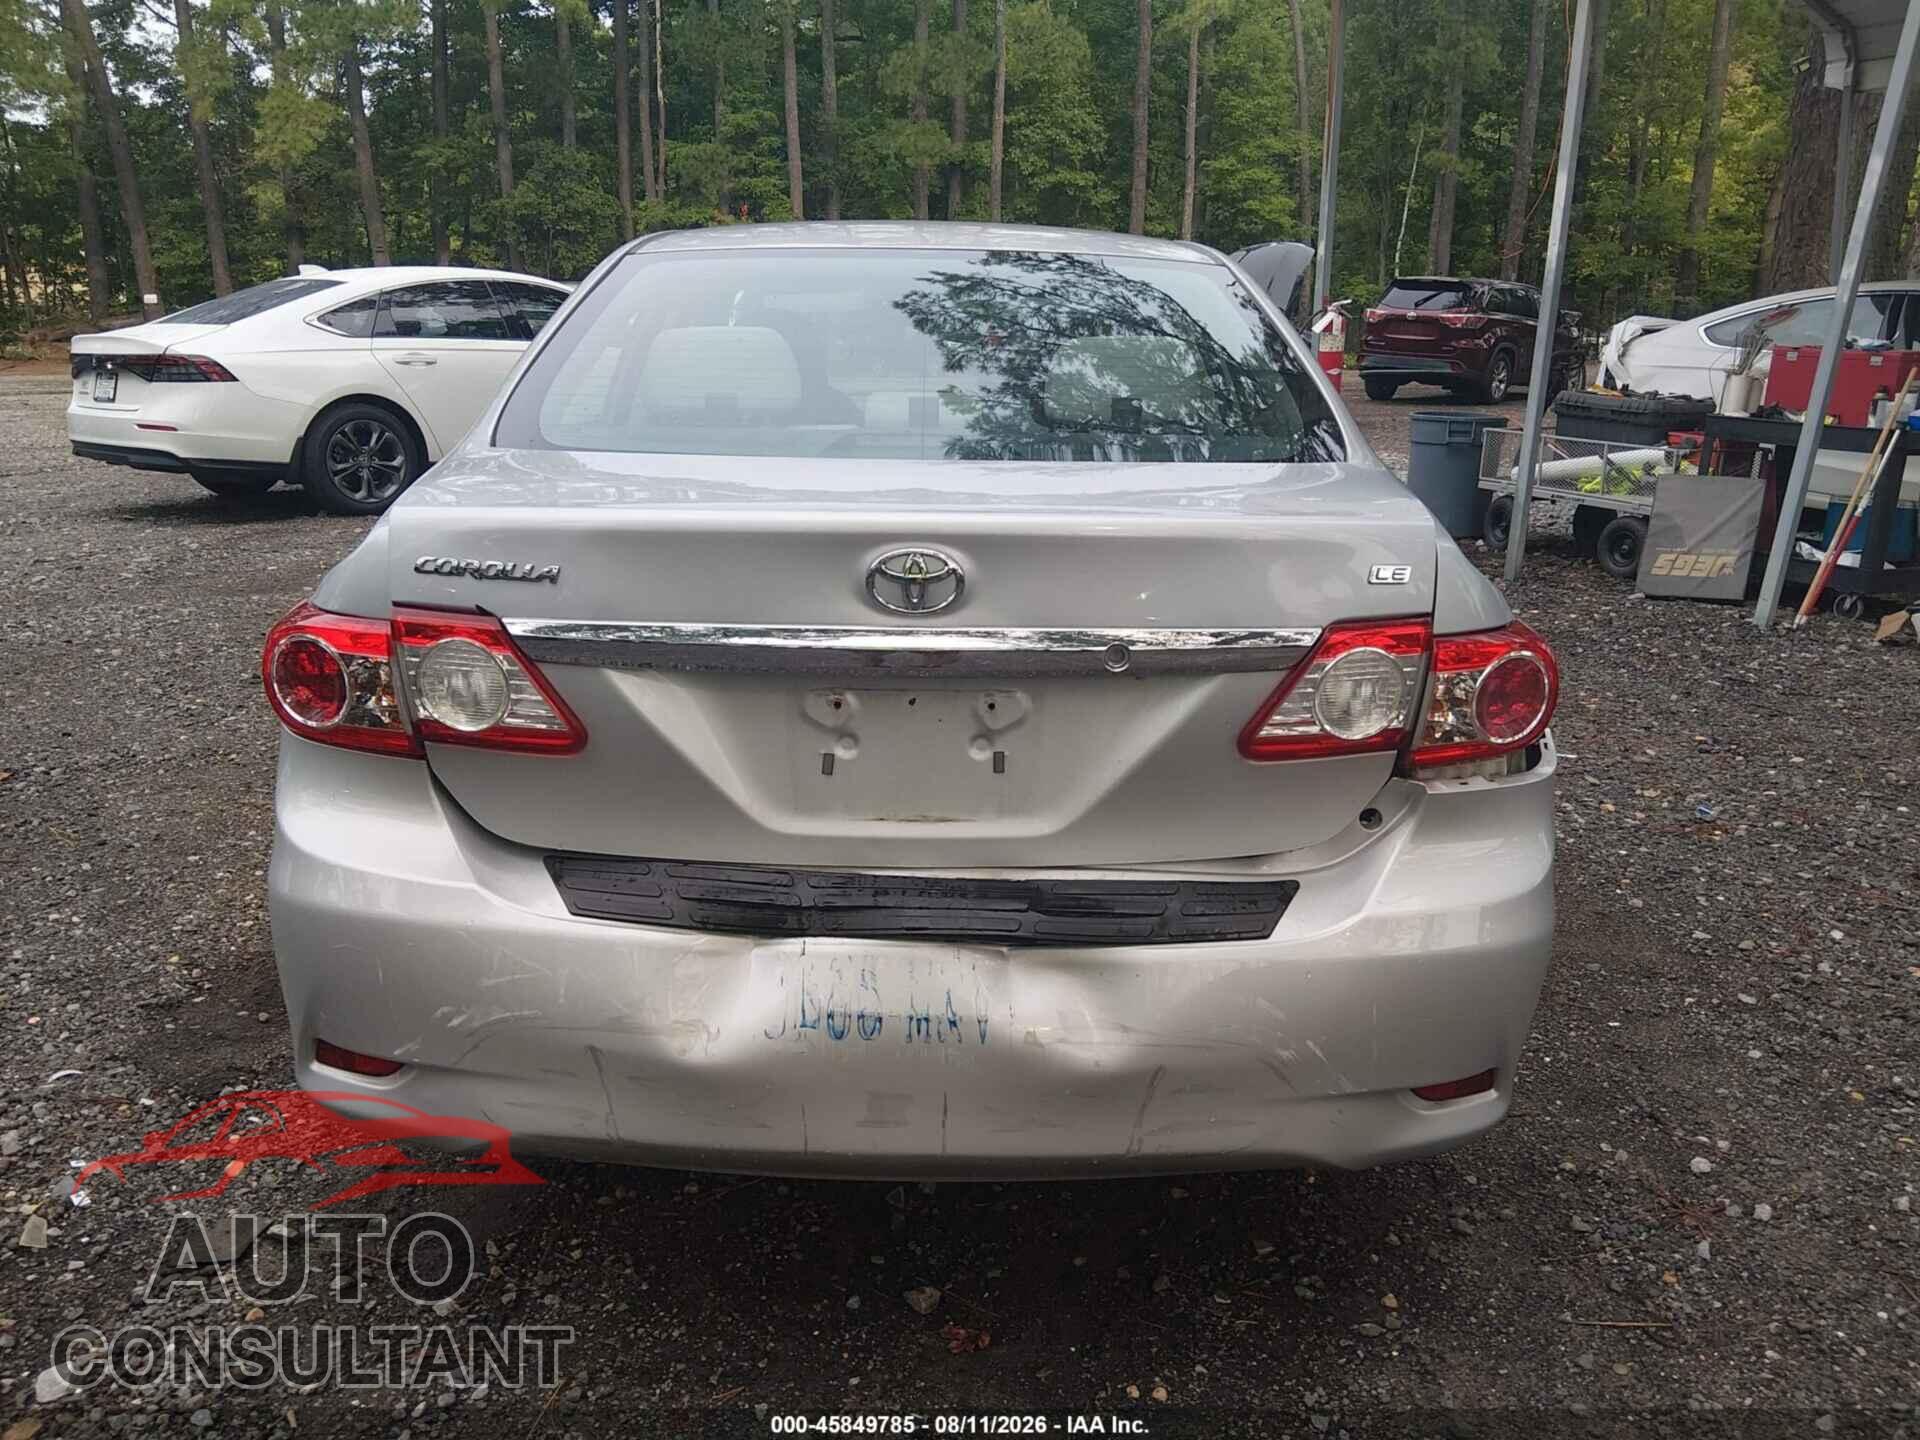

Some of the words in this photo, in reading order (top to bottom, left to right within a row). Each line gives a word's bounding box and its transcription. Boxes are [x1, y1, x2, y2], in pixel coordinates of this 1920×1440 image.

[414, 556, 561, 584] COROLLA
[1371, 565, 1409, 582] LE
[1650, 553, 1738, 577] JEGS
